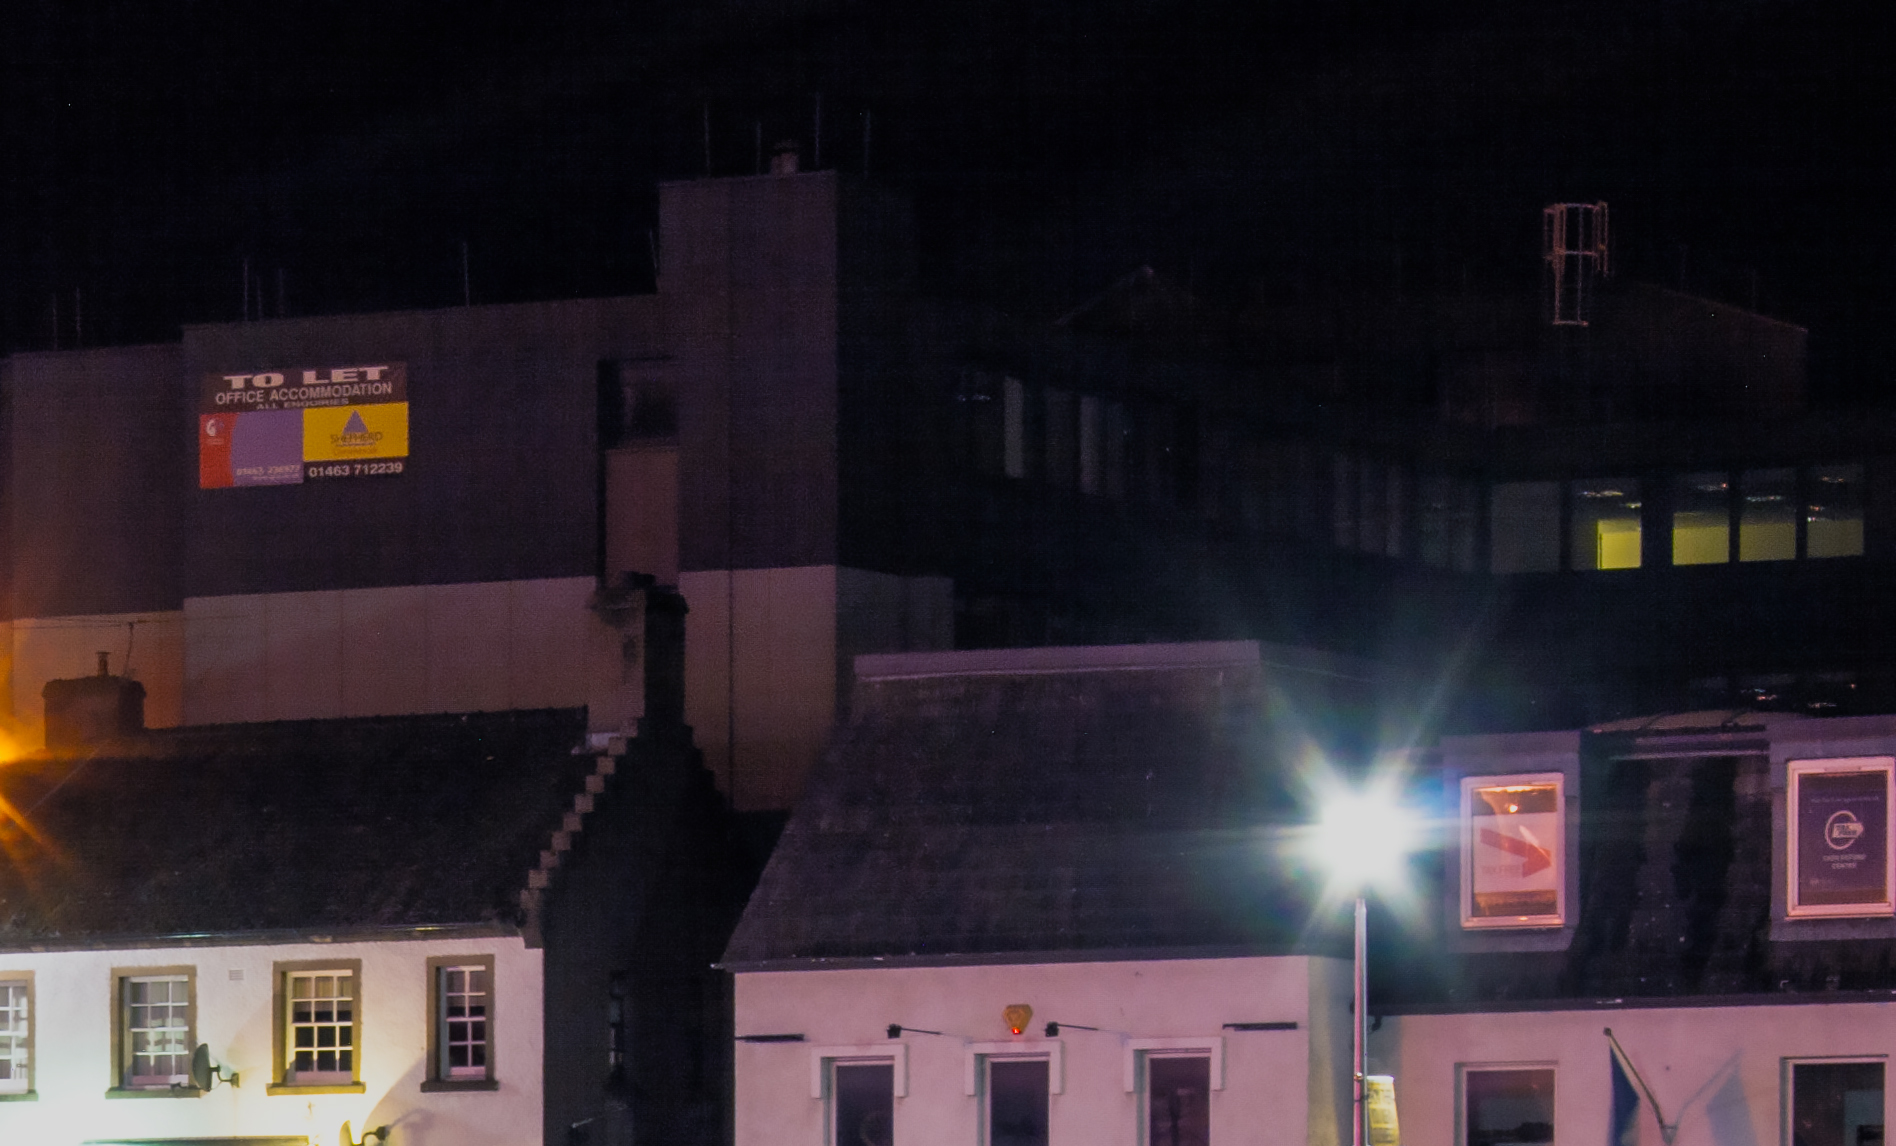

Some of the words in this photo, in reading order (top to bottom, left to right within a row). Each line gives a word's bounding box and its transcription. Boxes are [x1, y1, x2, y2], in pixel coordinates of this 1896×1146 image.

[223, 372, 284, 390] TO
[303, 365, 389, 384] LET
[215, 389, 264, 405] OFFICE
[270, 381, 393, 401] ACCOMMODATION
[309, 465, 350, 478] 01463
[354, 462, 404, 475] 712239
